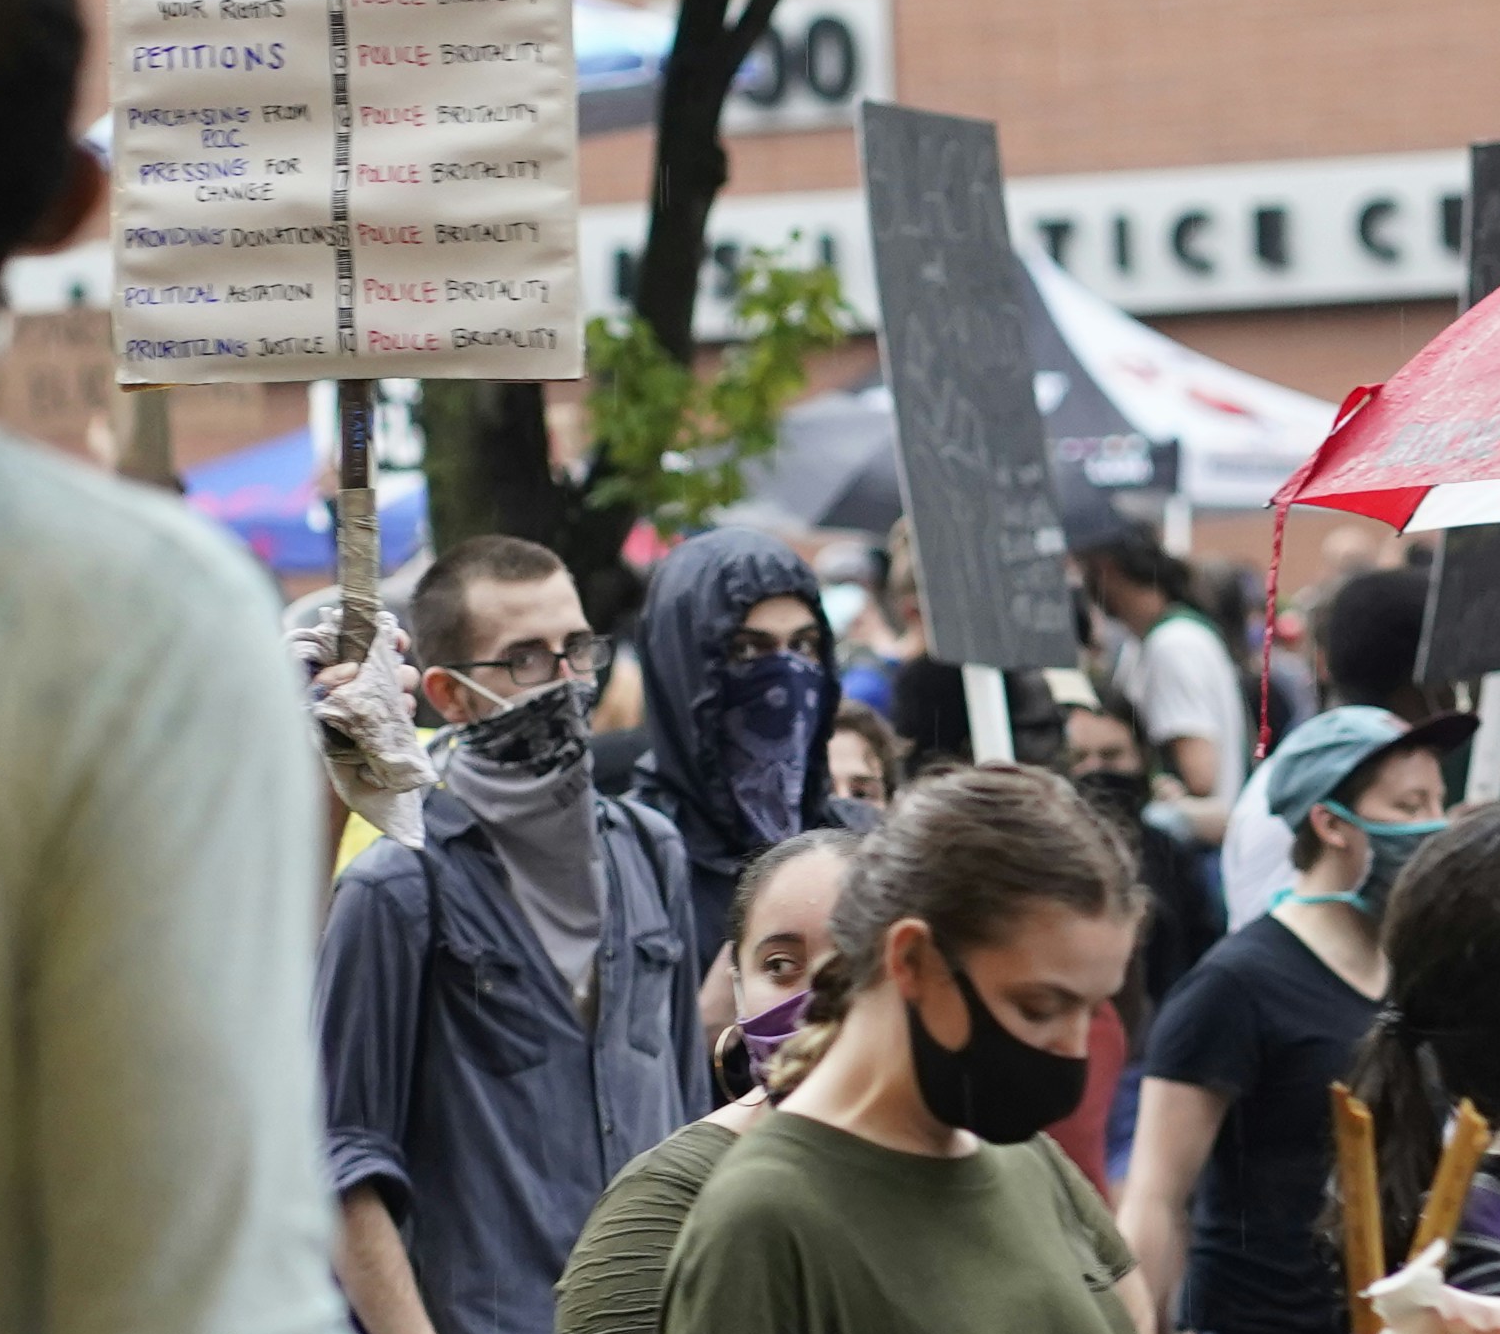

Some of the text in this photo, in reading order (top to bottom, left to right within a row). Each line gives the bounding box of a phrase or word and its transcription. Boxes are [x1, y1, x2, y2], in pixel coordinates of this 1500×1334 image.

[157, 0, 285, 20] YOUR RIGHTS
[133, 43, 285, 72] PETITIONS
[356, 42, 544, 67] POLICE BRUTALITY
[128, 104, 311, 129] PURCHASING FROM
[359, 103, 539, 127] POLICE BRUTALITY
[139, 158, 302, 184] PRESSING FOR
[356, 159, 541, 187] POLICE BRUTALITY
[195, 183, 276, 202] CHANGE
[124, 226, 336, 249] PROVIDING DONATIONS
[356, 221, 540, 246] POLICE BRUTALITY
[124, 284, 220, 308] POLITICAL
[363, 278, 550, 304] POLICE BRUTALITY
[124, 337, 328, 361] PRIORITIZING JUSTICE
[367, 328, 558, 354] POLICE BRUTALITY
